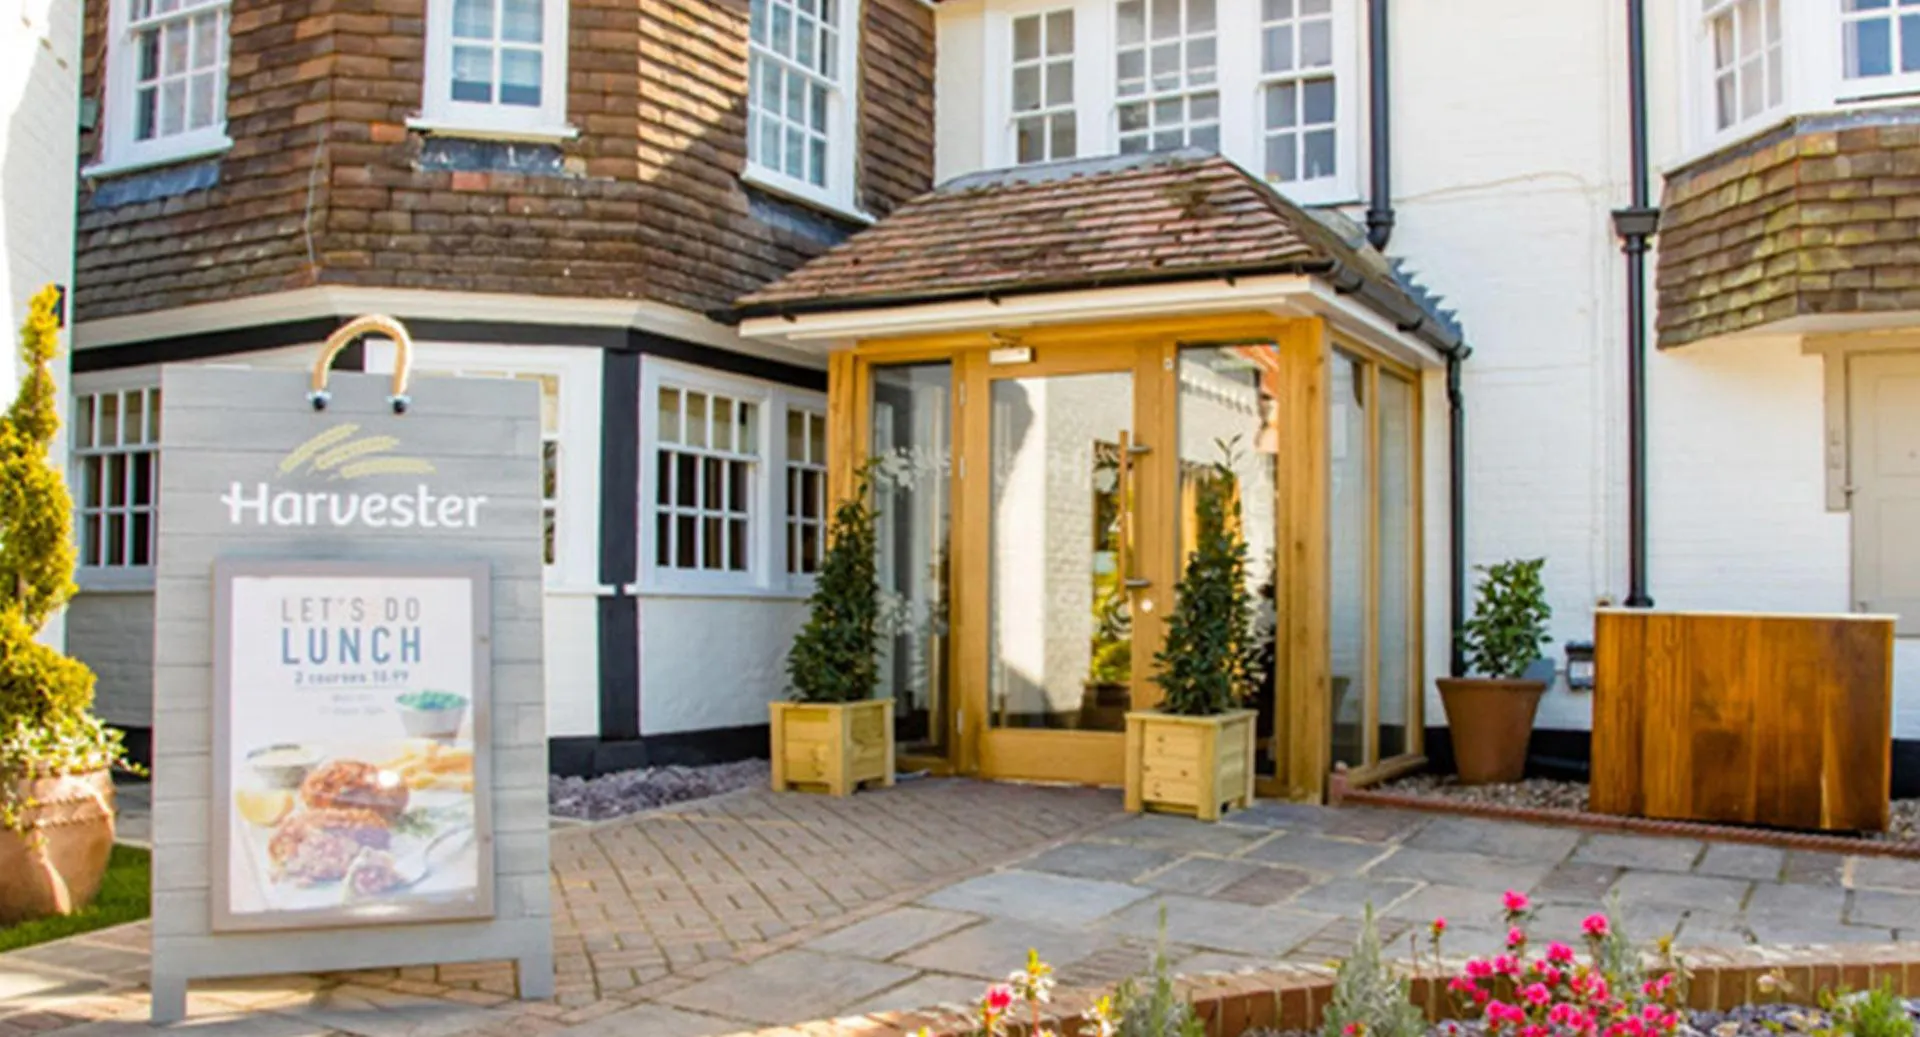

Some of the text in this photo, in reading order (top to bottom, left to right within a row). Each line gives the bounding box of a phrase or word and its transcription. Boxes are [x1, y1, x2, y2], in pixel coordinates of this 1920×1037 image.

[221, 481, 487, 528] Harvester
[281, 597, 421, 622] LET'S DO
[281, 626, 421, 665] LUNCH
